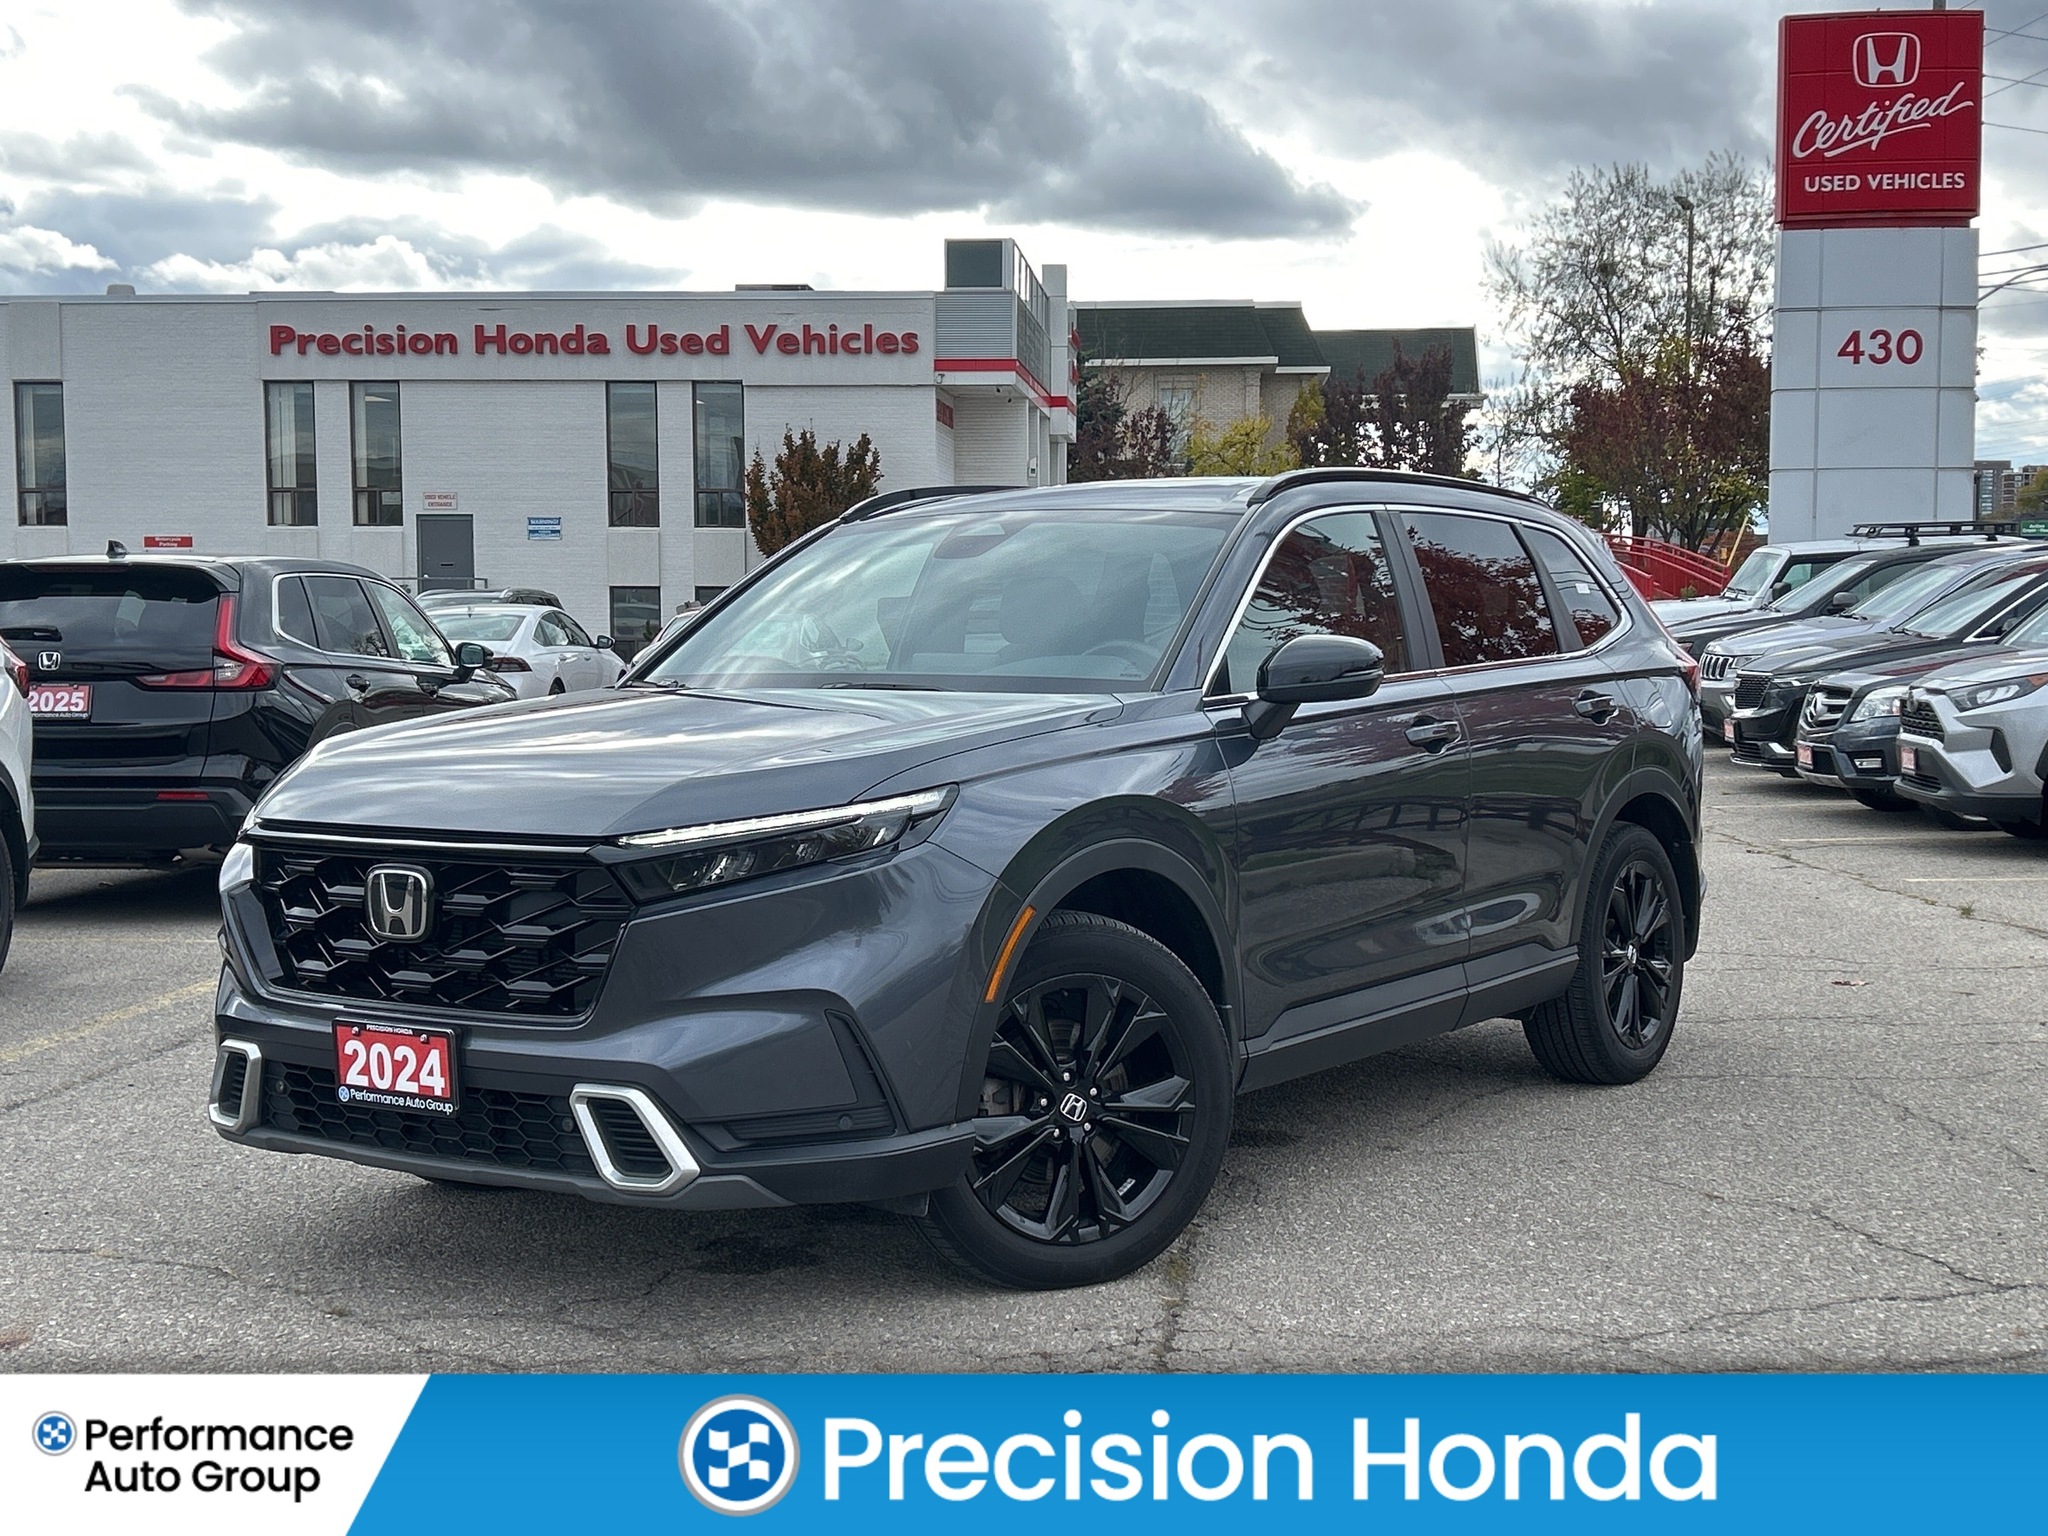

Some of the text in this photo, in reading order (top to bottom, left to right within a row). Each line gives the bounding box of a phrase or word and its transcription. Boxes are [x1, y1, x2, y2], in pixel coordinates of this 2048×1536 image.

[1793, 81, 1974, 158] Certified
[1804, 173, 1965, 192] USED VEHICLES
[270, 324, 919, 354] Precision Honda Used Vehicles
[1838, 330, 1923, 364] 430
[29, 691, 85, 712] 2025
[343, 1039, 446, 1097] 2024
[350, 1089, 454, 1115] Performance Auto Group
